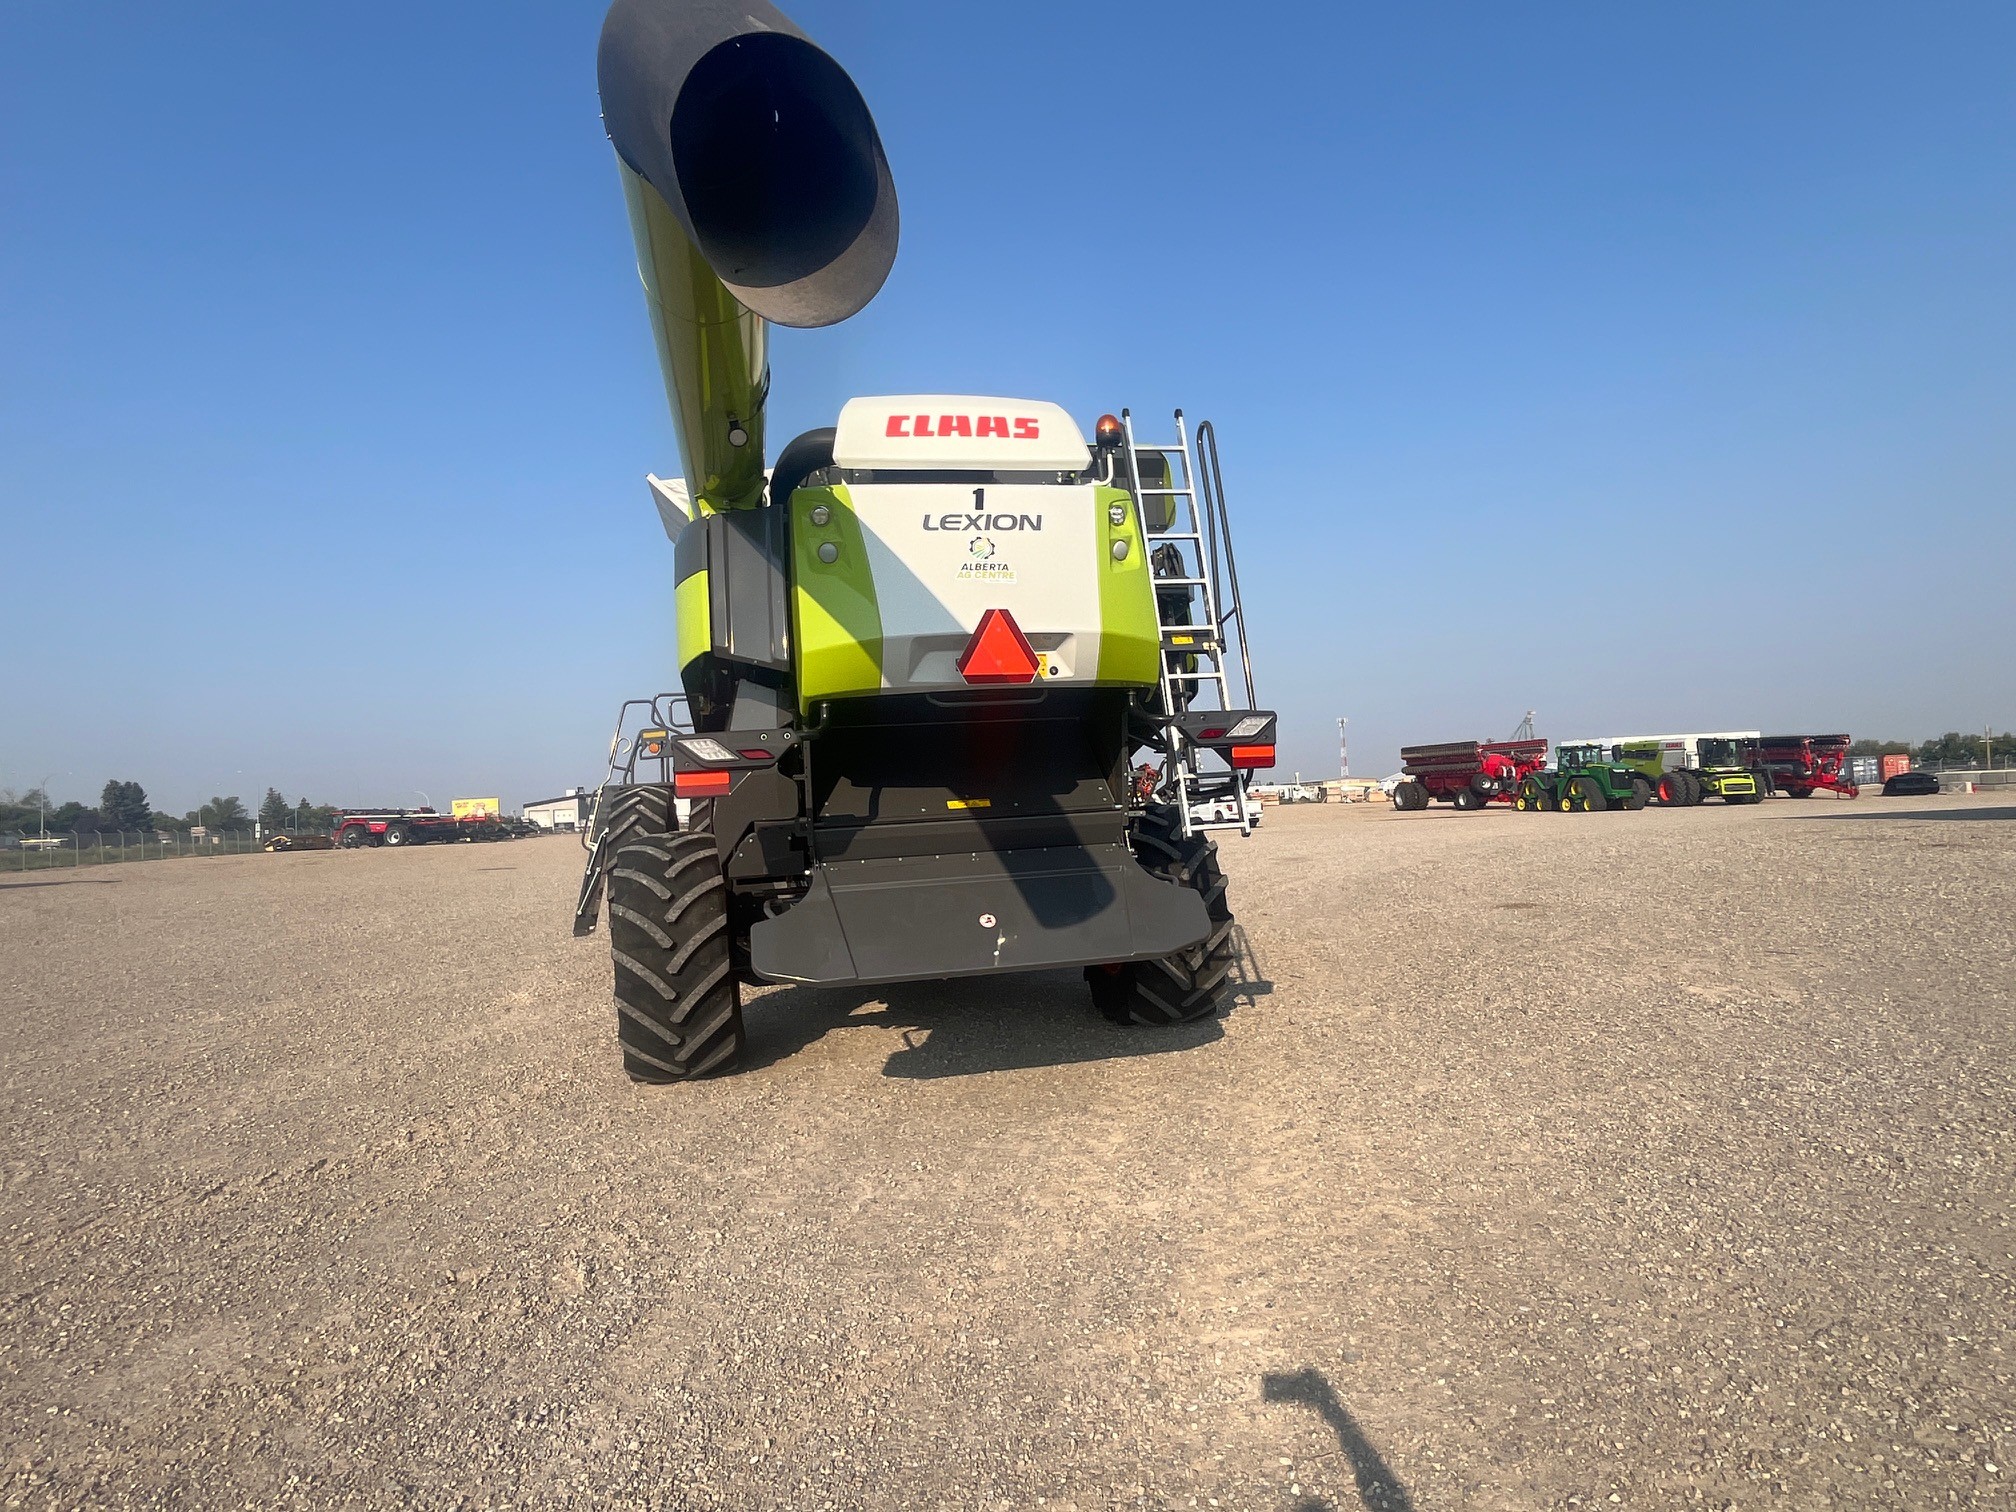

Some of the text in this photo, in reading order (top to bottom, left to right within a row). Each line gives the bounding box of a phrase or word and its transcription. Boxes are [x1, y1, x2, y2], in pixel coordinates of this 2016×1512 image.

[885, 415, 1039, 439] CLAAS
[972, 488, 985, 511] 1
[922, 513, 1043, 531] LEXION
[956, 571, 1015, 579] AG CENTRE
[961, 563, 1009, 571] ALBERTA
